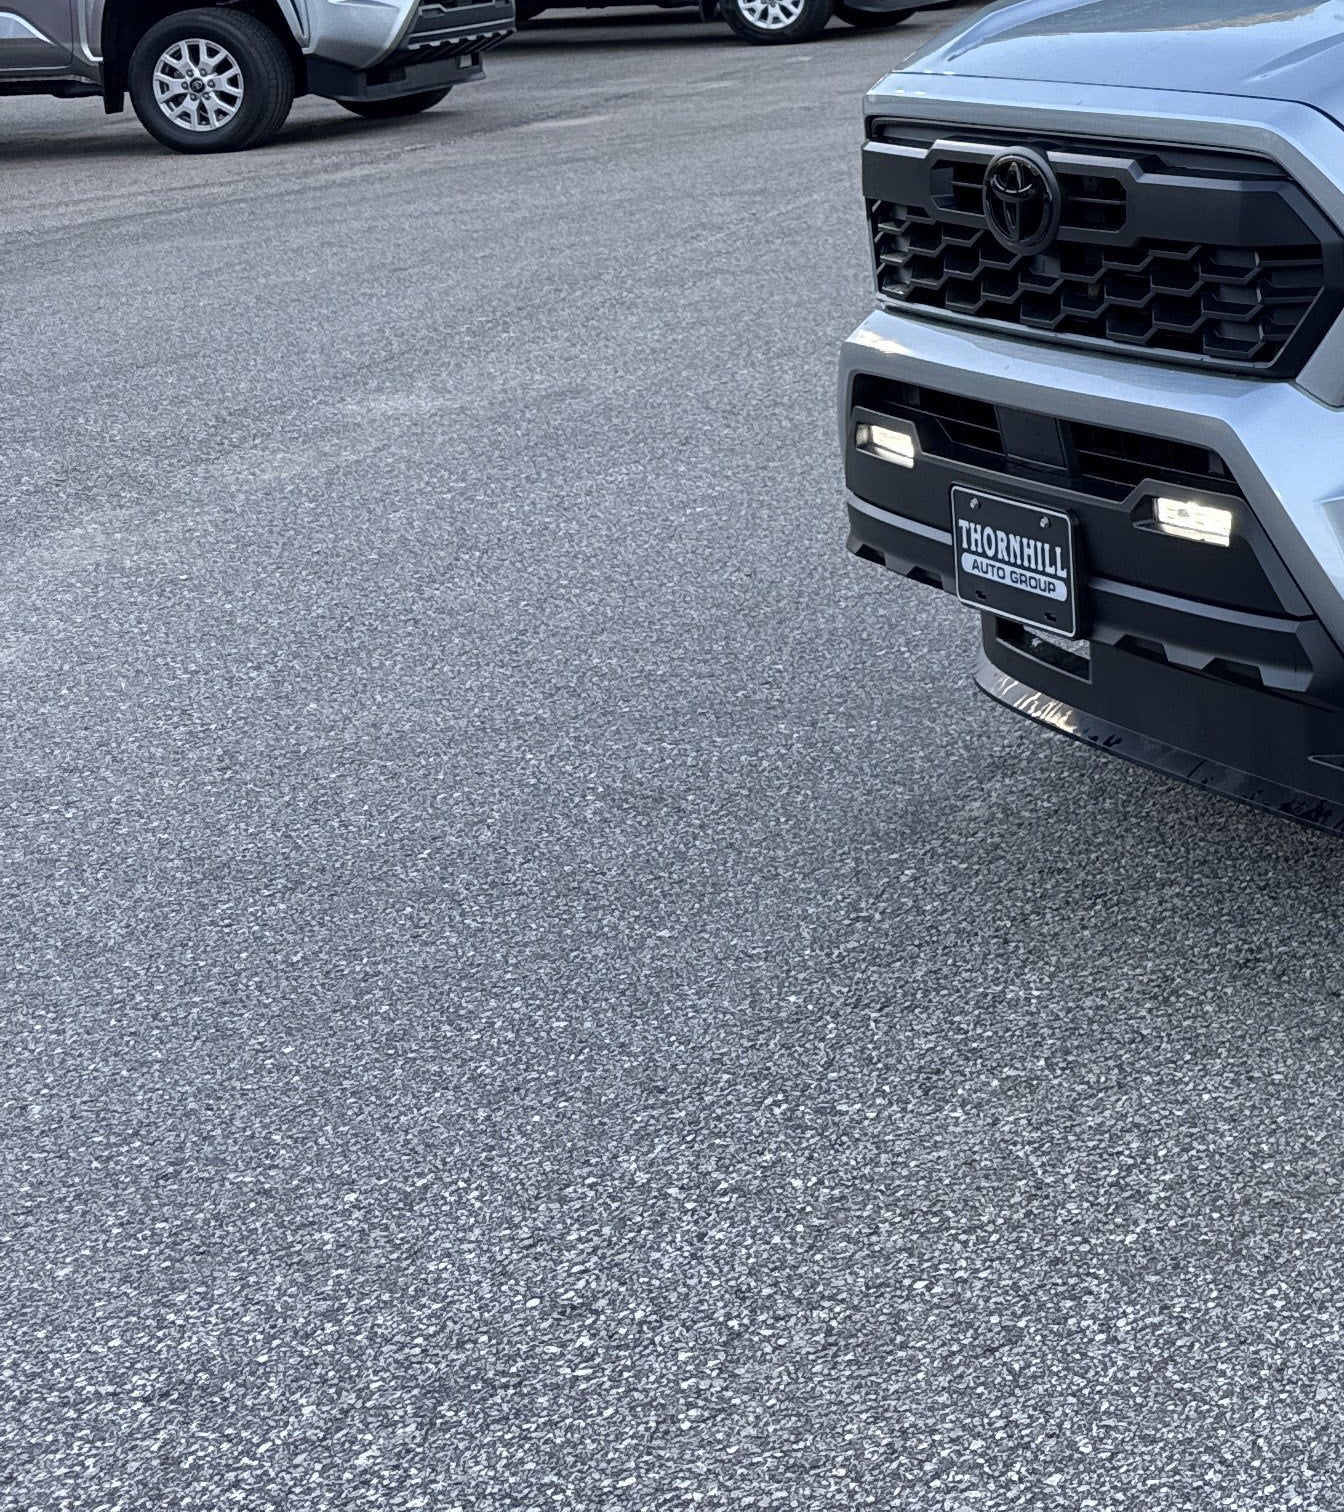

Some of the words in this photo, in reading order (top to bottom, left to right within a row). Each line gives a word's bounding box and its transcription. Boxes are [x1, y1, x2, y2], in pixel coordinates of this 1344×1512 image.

[958, 518, 1068, 579] THORNHILL
[971, 558, 1006, 580] AUTO
[1009, 570, 1056, 595] GROUP
